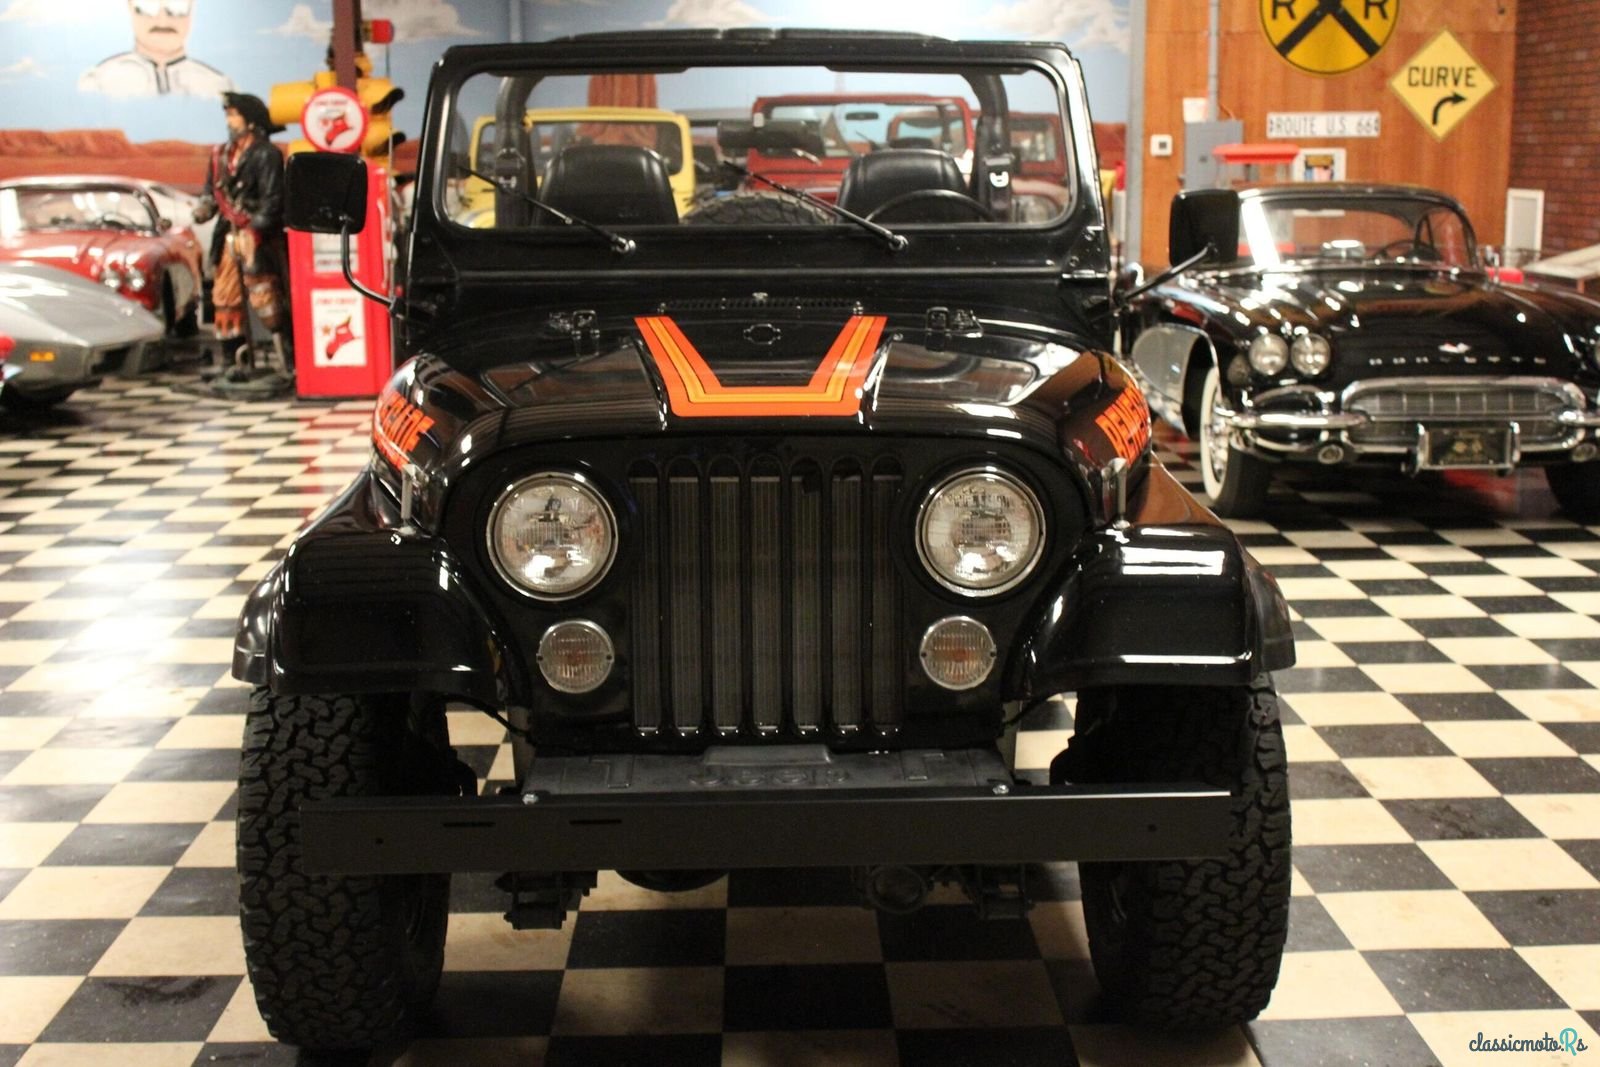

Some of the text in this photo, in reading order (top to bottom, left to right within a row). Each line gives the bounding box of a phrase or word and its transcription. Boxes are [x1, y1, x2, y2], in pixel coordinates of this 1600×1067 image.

[1272, 0, 1388, 19] R R
[1408, 66, 1477, 88] CURVE
[1275, 116, 1317, 134] ROUTE
[1355, 117, 1373, 134] 66
